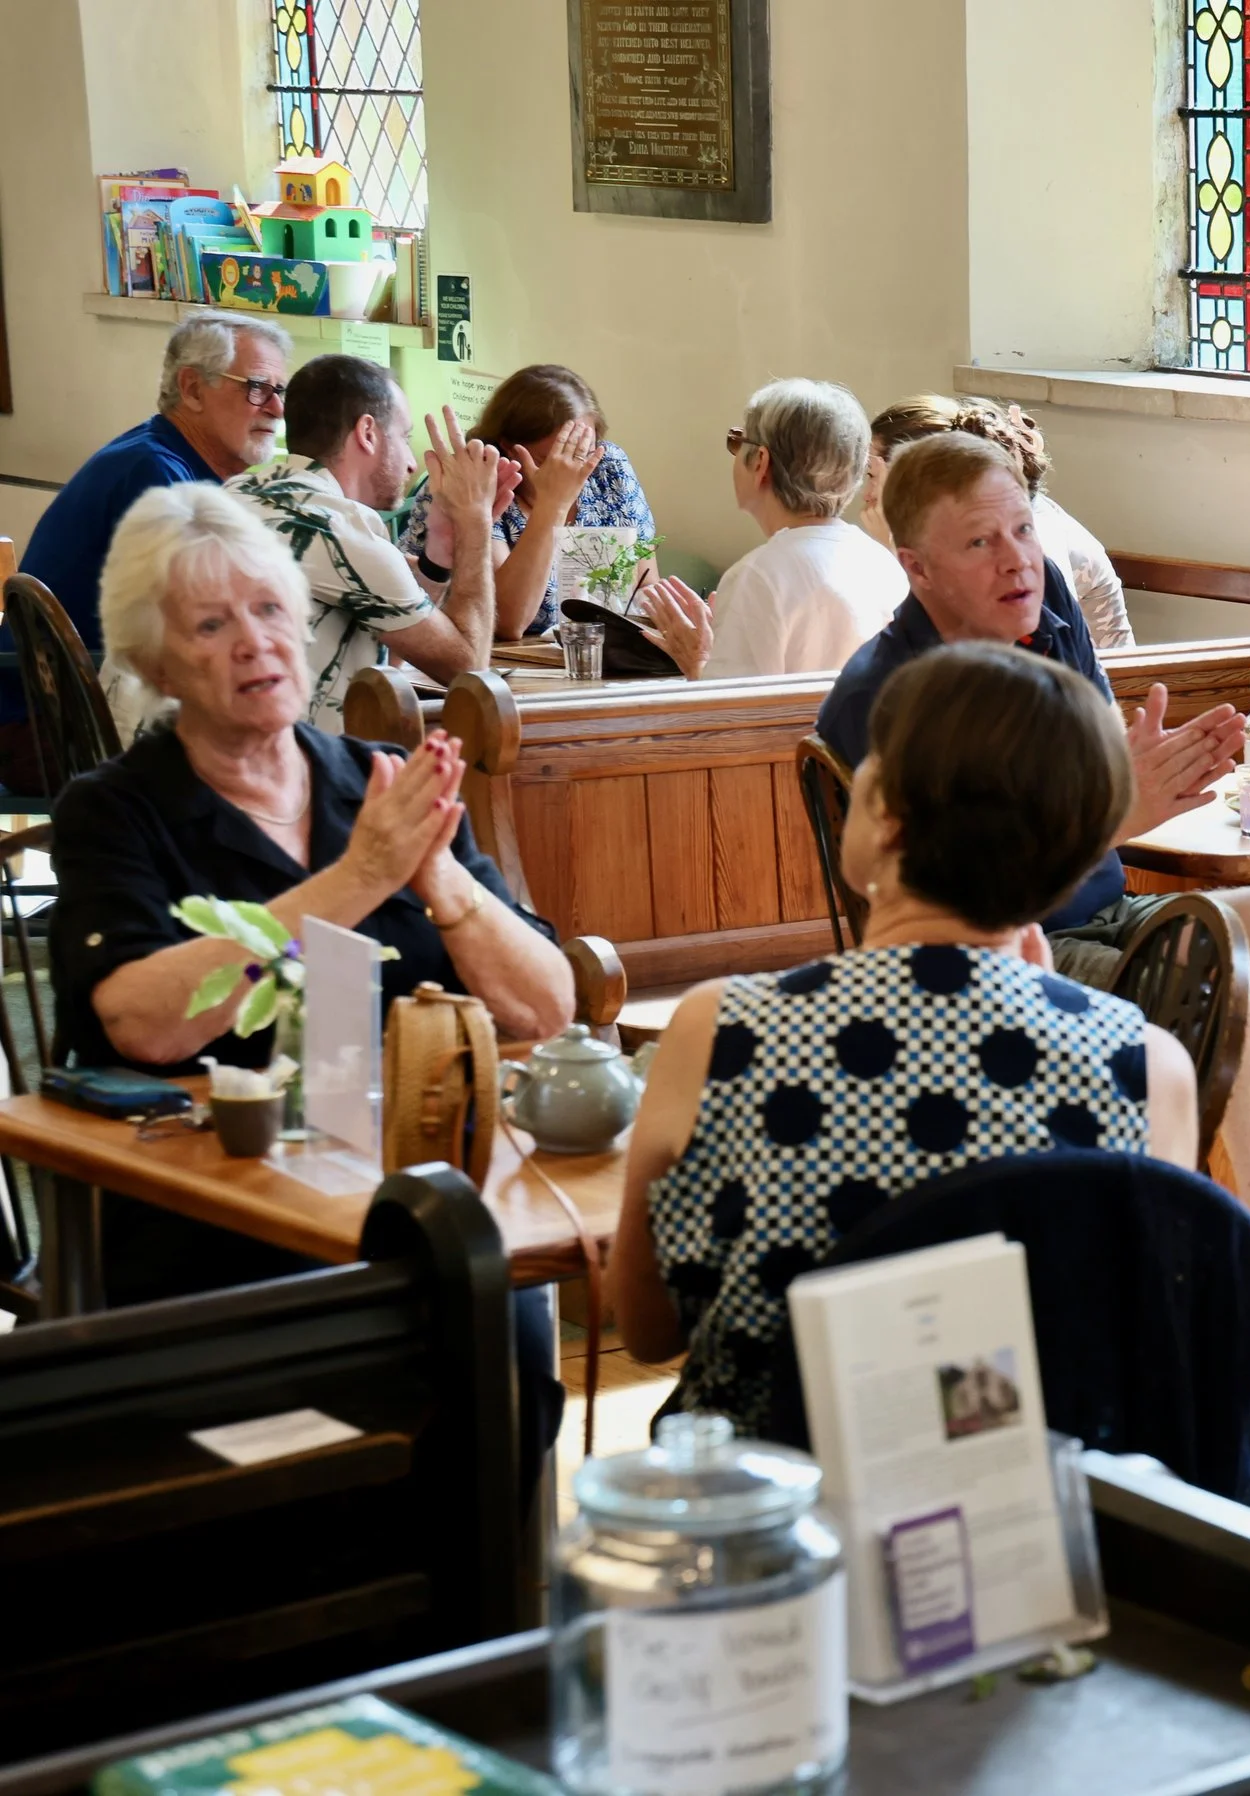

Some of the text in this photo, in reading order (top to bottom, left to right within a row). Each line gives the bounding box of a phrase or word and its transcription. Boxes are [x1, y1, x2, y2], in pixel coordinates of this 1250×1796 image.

[633, 6, 654, 16] FAITH
[655, 6, 670, 17] AND
[692, 7, 710, 17] THEY
[648, 22, 669, 32] THEIR
[660, 38, 678, 49] REST
[462, 380, 475, 391] hope
[476, 384, 486, 392] you
